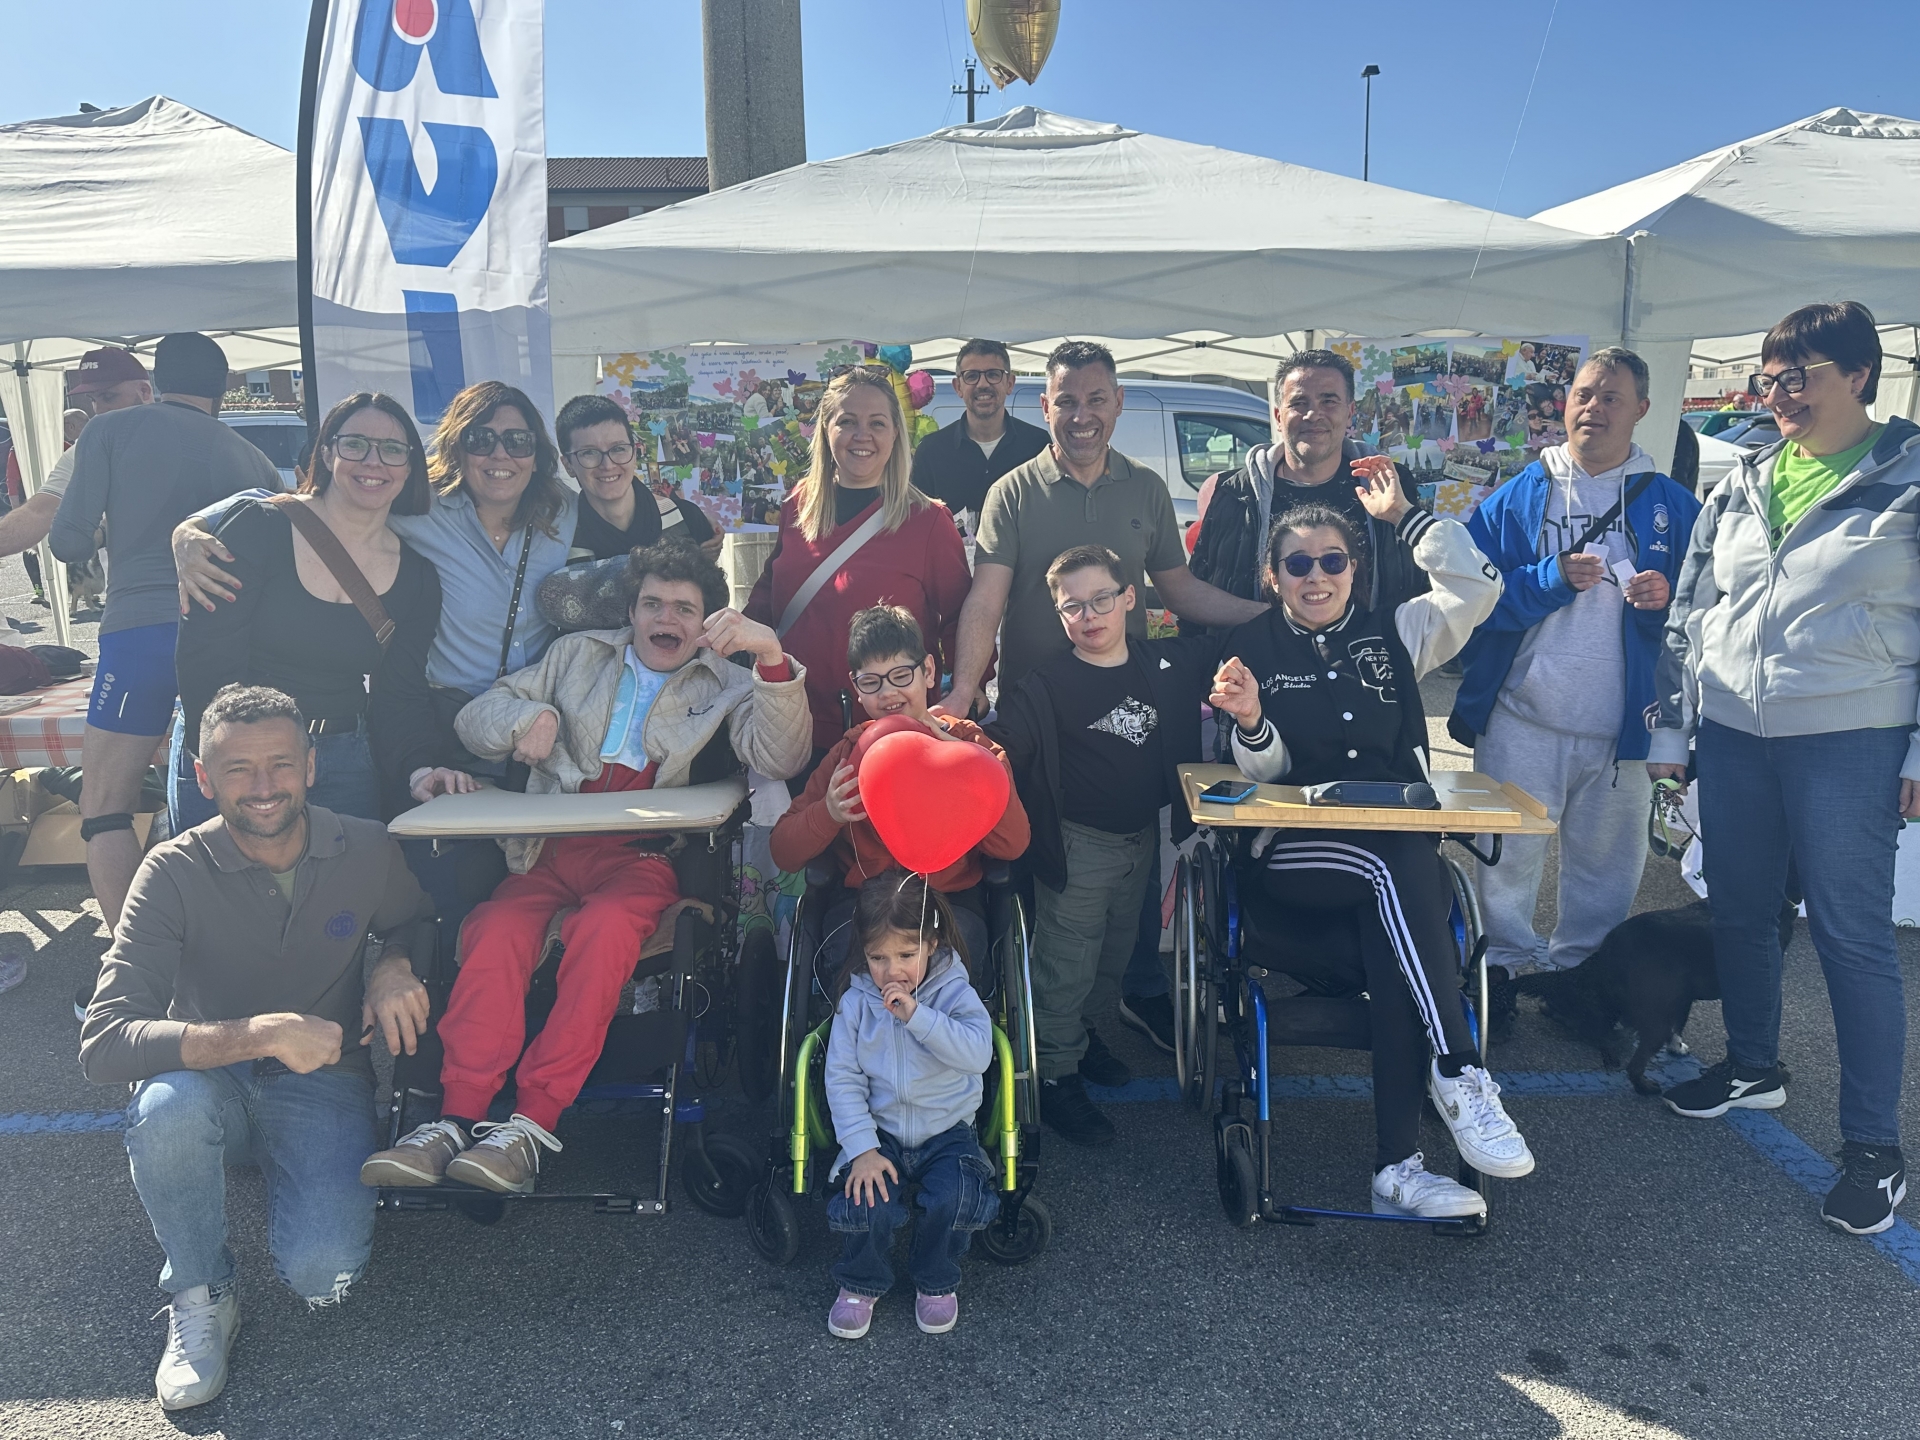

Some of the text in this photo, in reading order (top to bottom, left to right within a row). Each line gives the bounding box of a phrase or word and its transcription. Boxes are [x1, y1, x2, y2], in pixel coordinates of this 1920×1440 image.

[1261, 673, 1317, 690] LOS ANGELES
[1282, 681, 1312, 689] Studio
